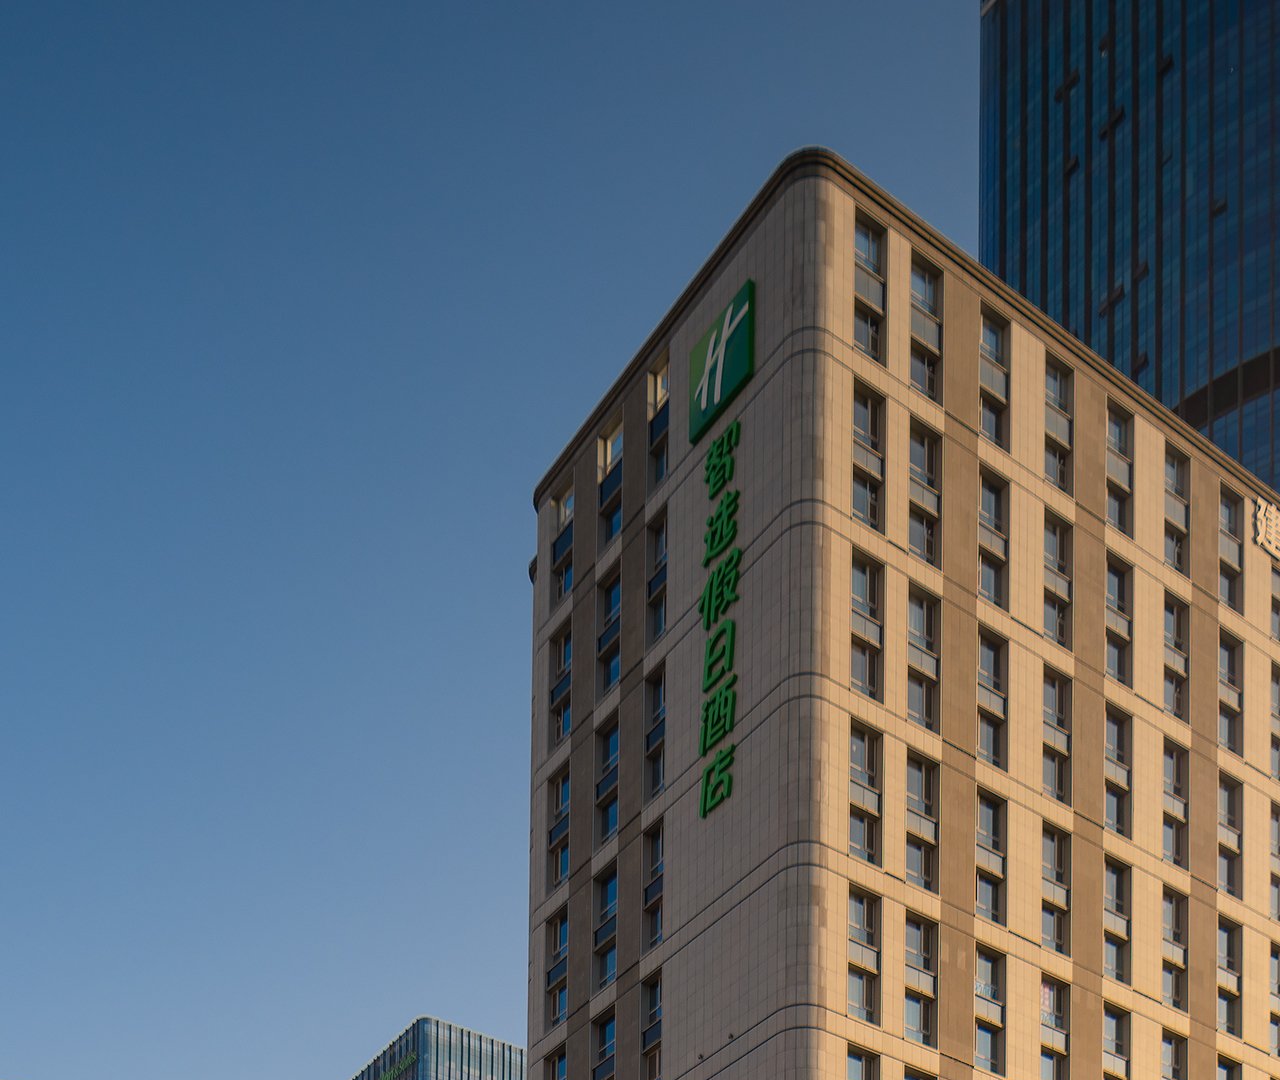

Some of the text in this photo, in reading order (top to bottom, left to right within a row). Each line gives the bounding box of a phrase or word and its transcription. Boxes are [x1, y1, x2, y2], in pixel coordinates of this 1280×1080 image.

[698, 420, 741, 818] 智选假日酒店
